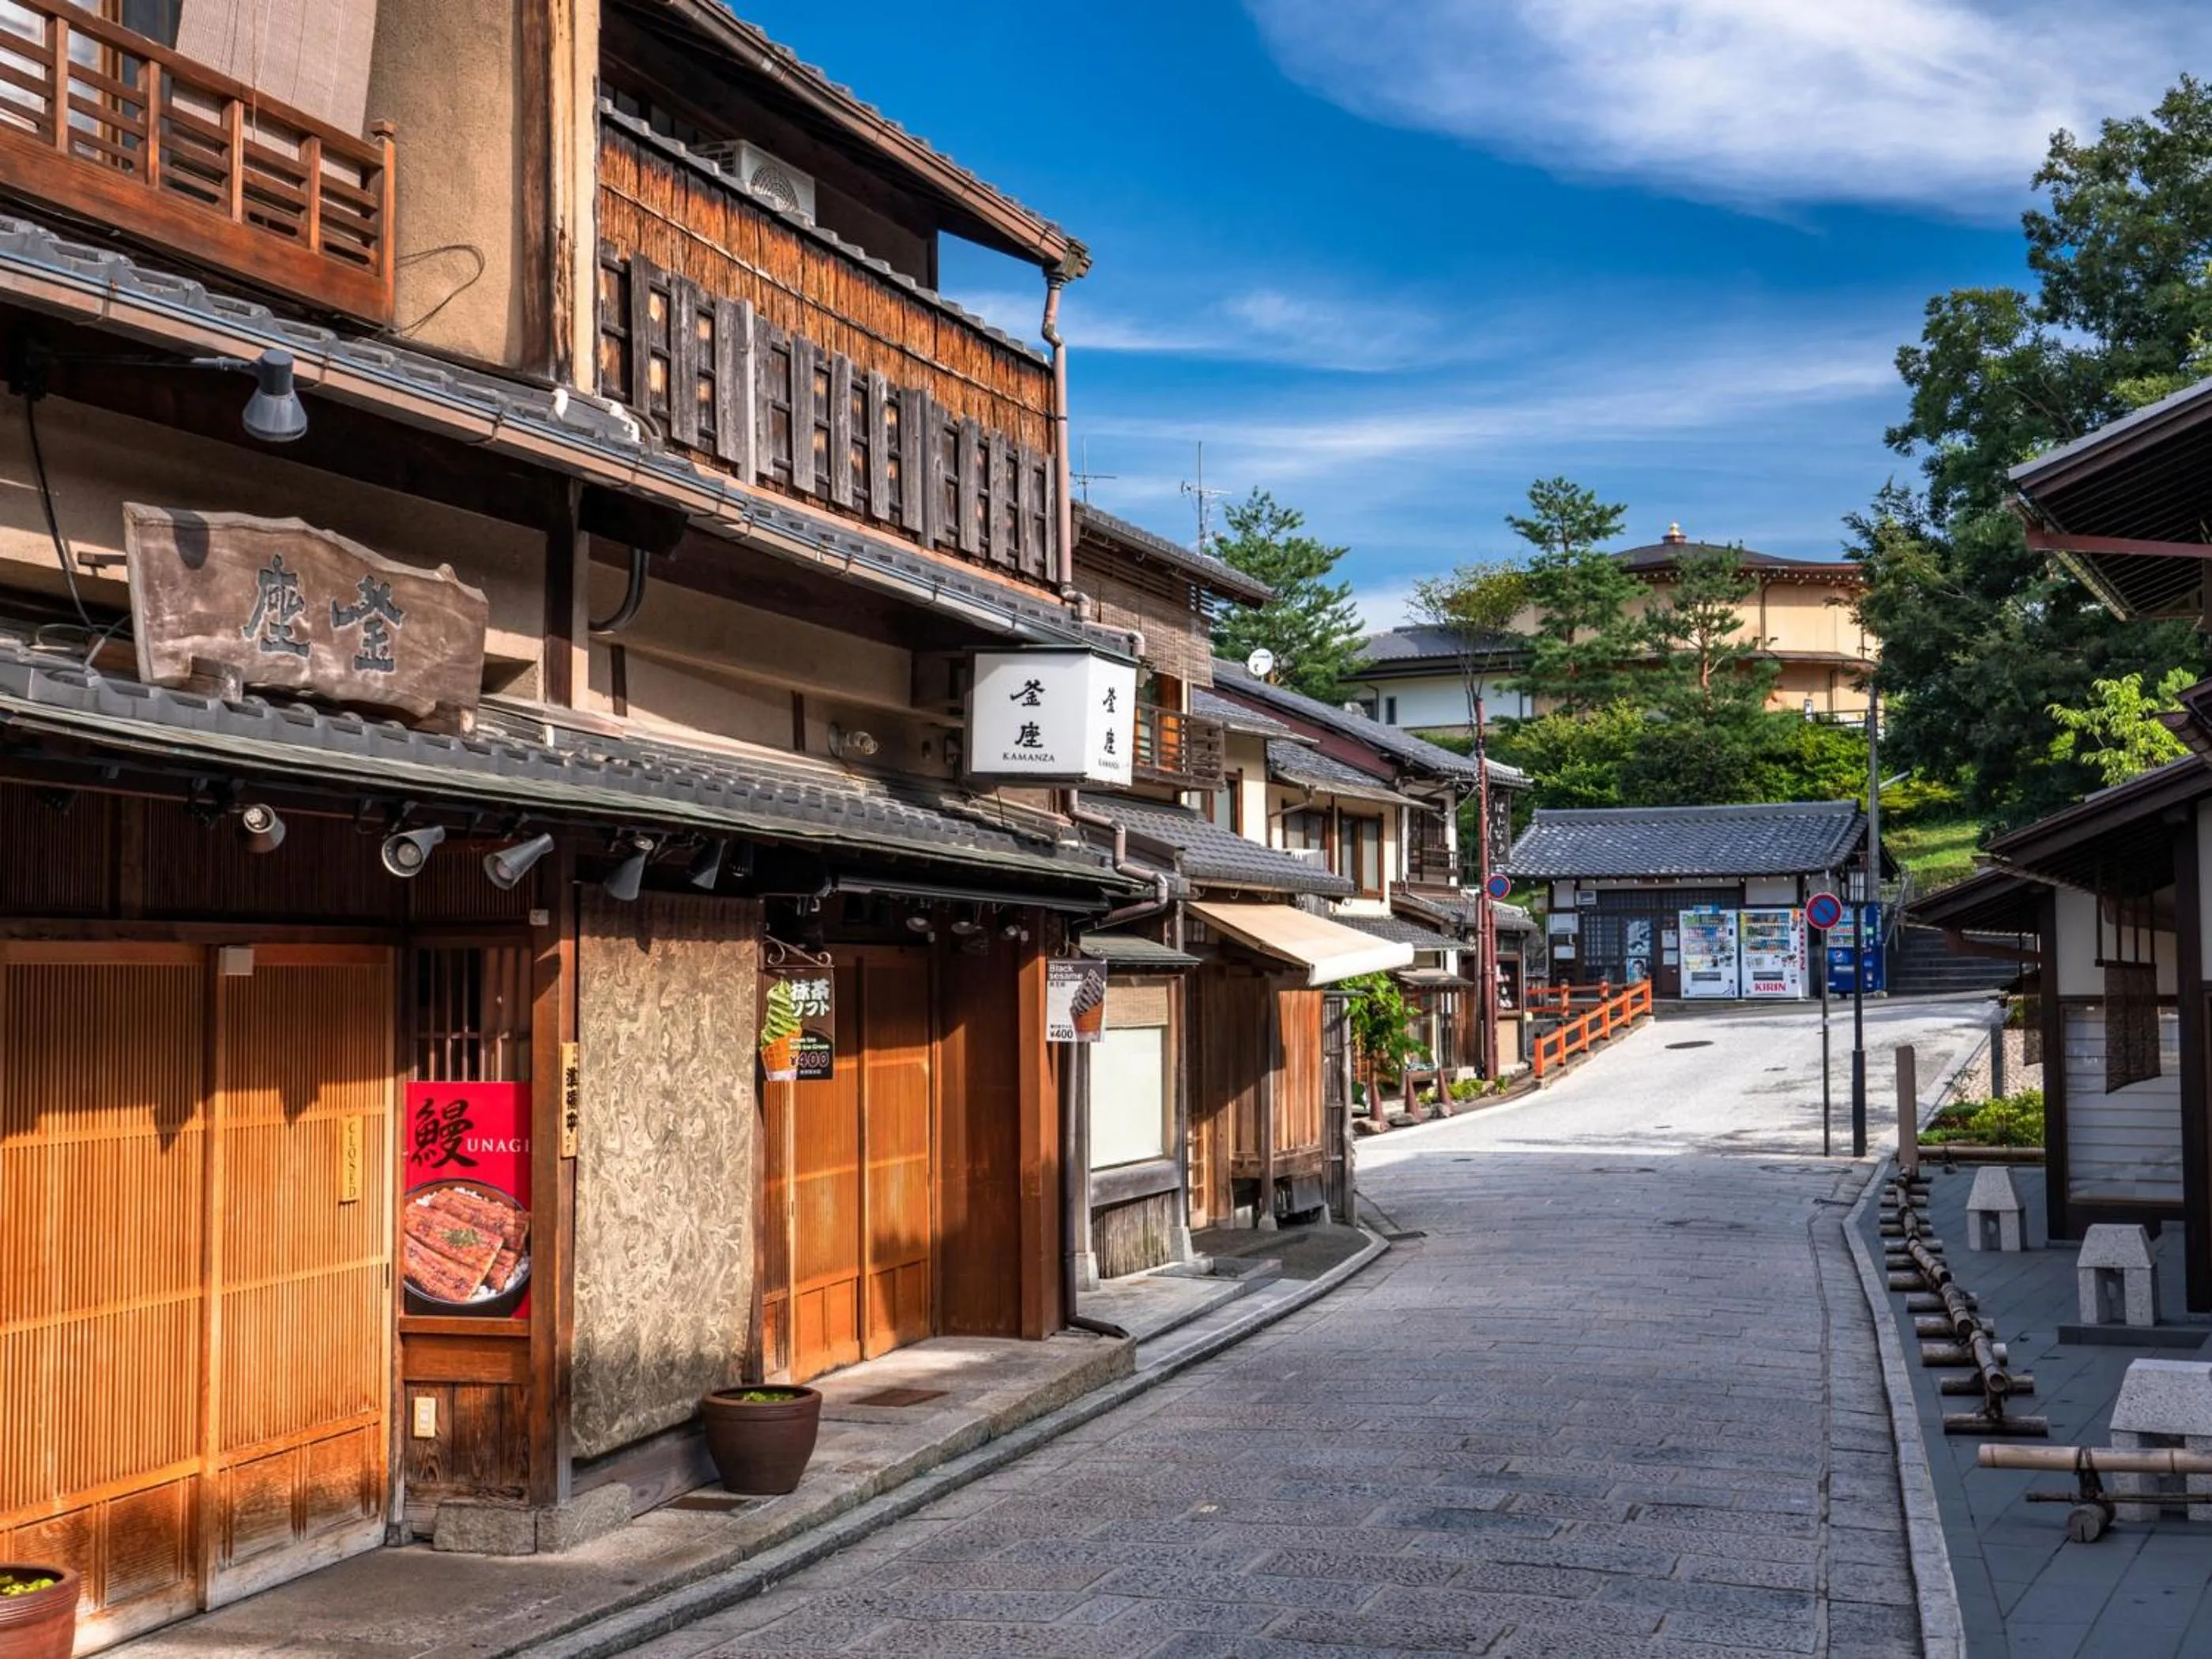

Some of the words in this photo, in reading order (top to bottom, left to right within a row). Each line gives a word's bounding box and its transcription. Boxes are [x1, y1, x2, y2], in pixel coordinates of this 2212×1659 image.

[1010, 679, 1045, 748] 釜座
[1103, 687, 1116, 755] 釜座
[1003, 752, 1055, 762] KAMANZA
[1049, 964, 1074, 972] Black
[791, 979, 830, 1001] 抹茶
[1754, 983, 1787, 992] KIRIN
[791, 1001, 830, 1017] ソフト
[1051, 1029, 1073, 1039] ¥400
[790, 1051, 829, 1067] ¥400
[411, 1098, 480, 1168] 鰻
[467, 1138, 529, 1153] UNAGI
[348, 1121, 356, 1198] CLOSED
